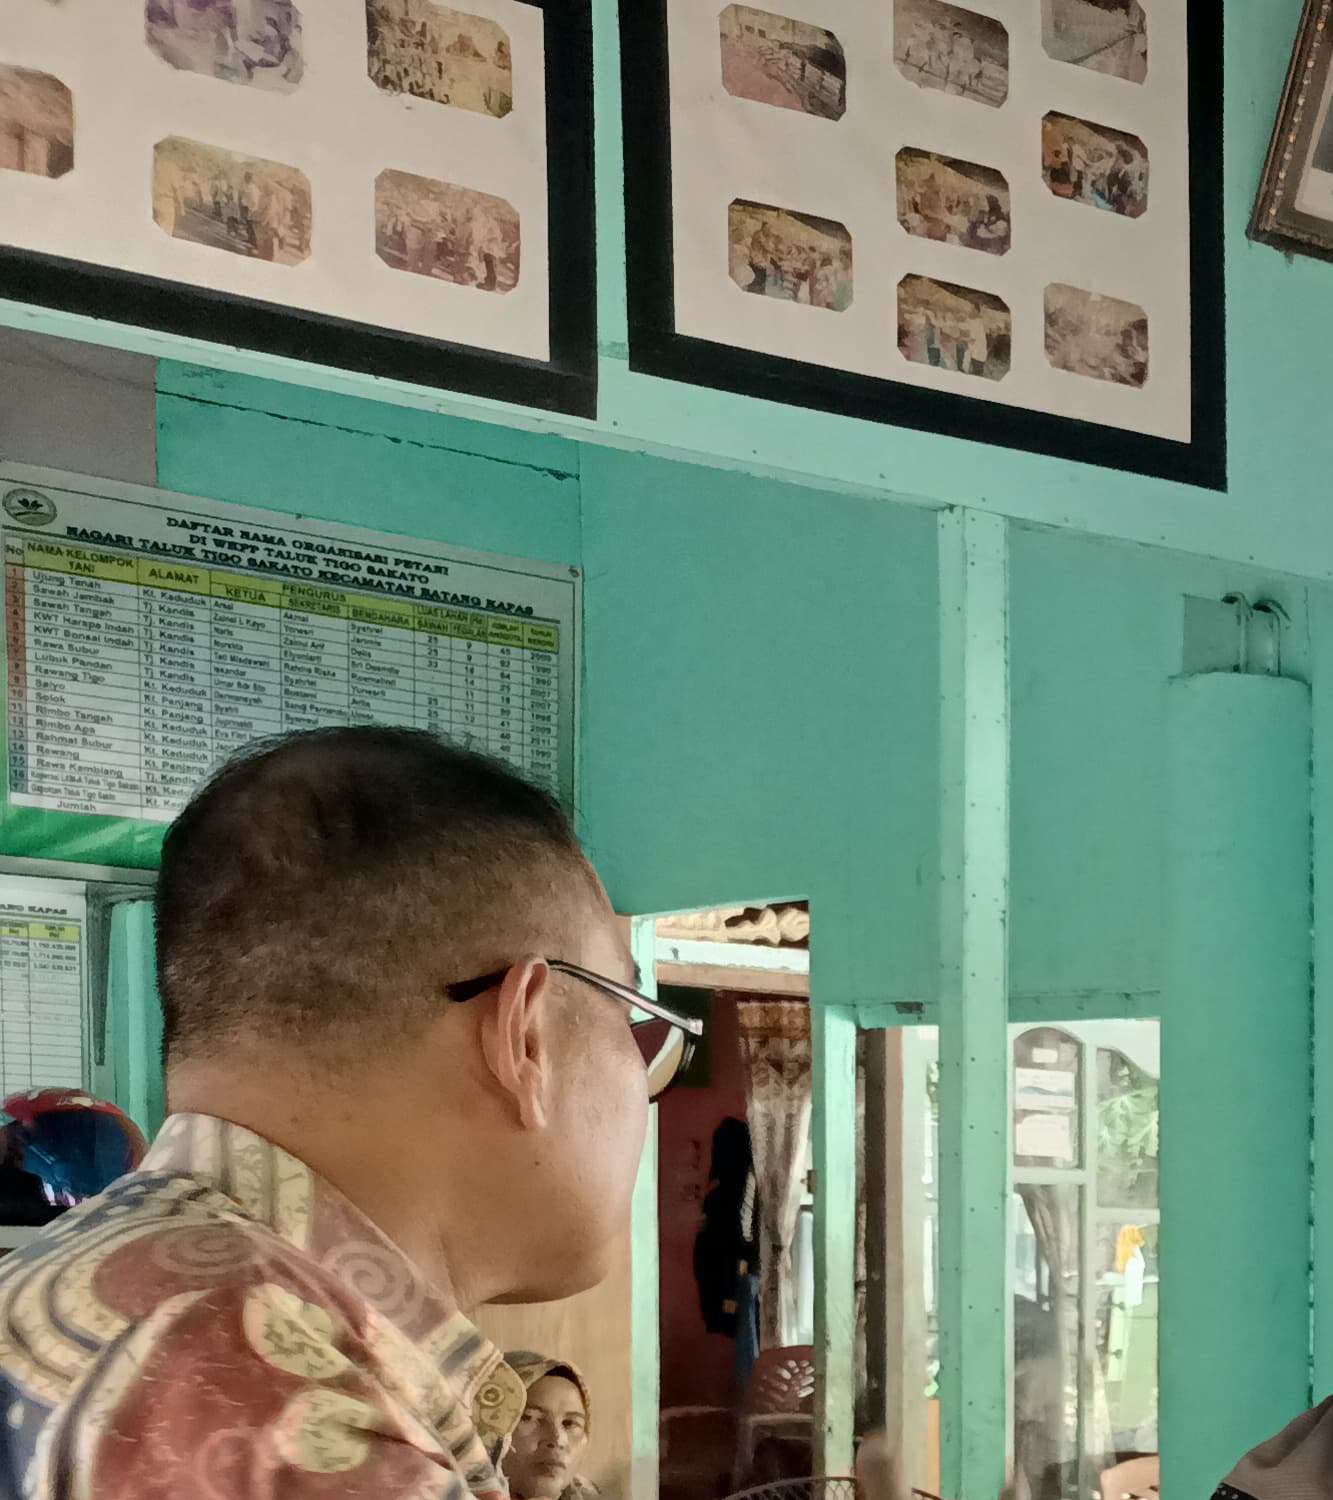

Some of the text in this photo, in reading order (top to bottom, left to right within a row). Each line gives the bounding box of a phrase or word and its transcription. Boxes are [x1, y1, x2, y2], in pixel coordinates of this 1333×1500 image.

[166, 517, 235, 538] DAFTAR
[240, 530, 287, 547] NAMA
[394, 558, 449, 576] PETANI
[27, 542, 134, 569] NAMA KELOMPOK
[189, 534, 206, 546] DI
[265, 548, 319, 565] TALUK
[323, 558, 363, 573] TIGO
[366, 566, 430, 585] SAKATO
[66, 526, 534, 617] NAGARI TALUK TIGO SAKATO KECAMATAN BATANG KAPAS
[69, 561, 95, 573] TANI
[32, 571, 65, 587] Ujung
[149, 568, 199, 585] ALAMAT
[225, 586, 266, 603] KETUA
[281, 583, 347, 603] PENGURUS
[33, 612, 60, 623] KWT
[33, 625, 60, 636] KWT
